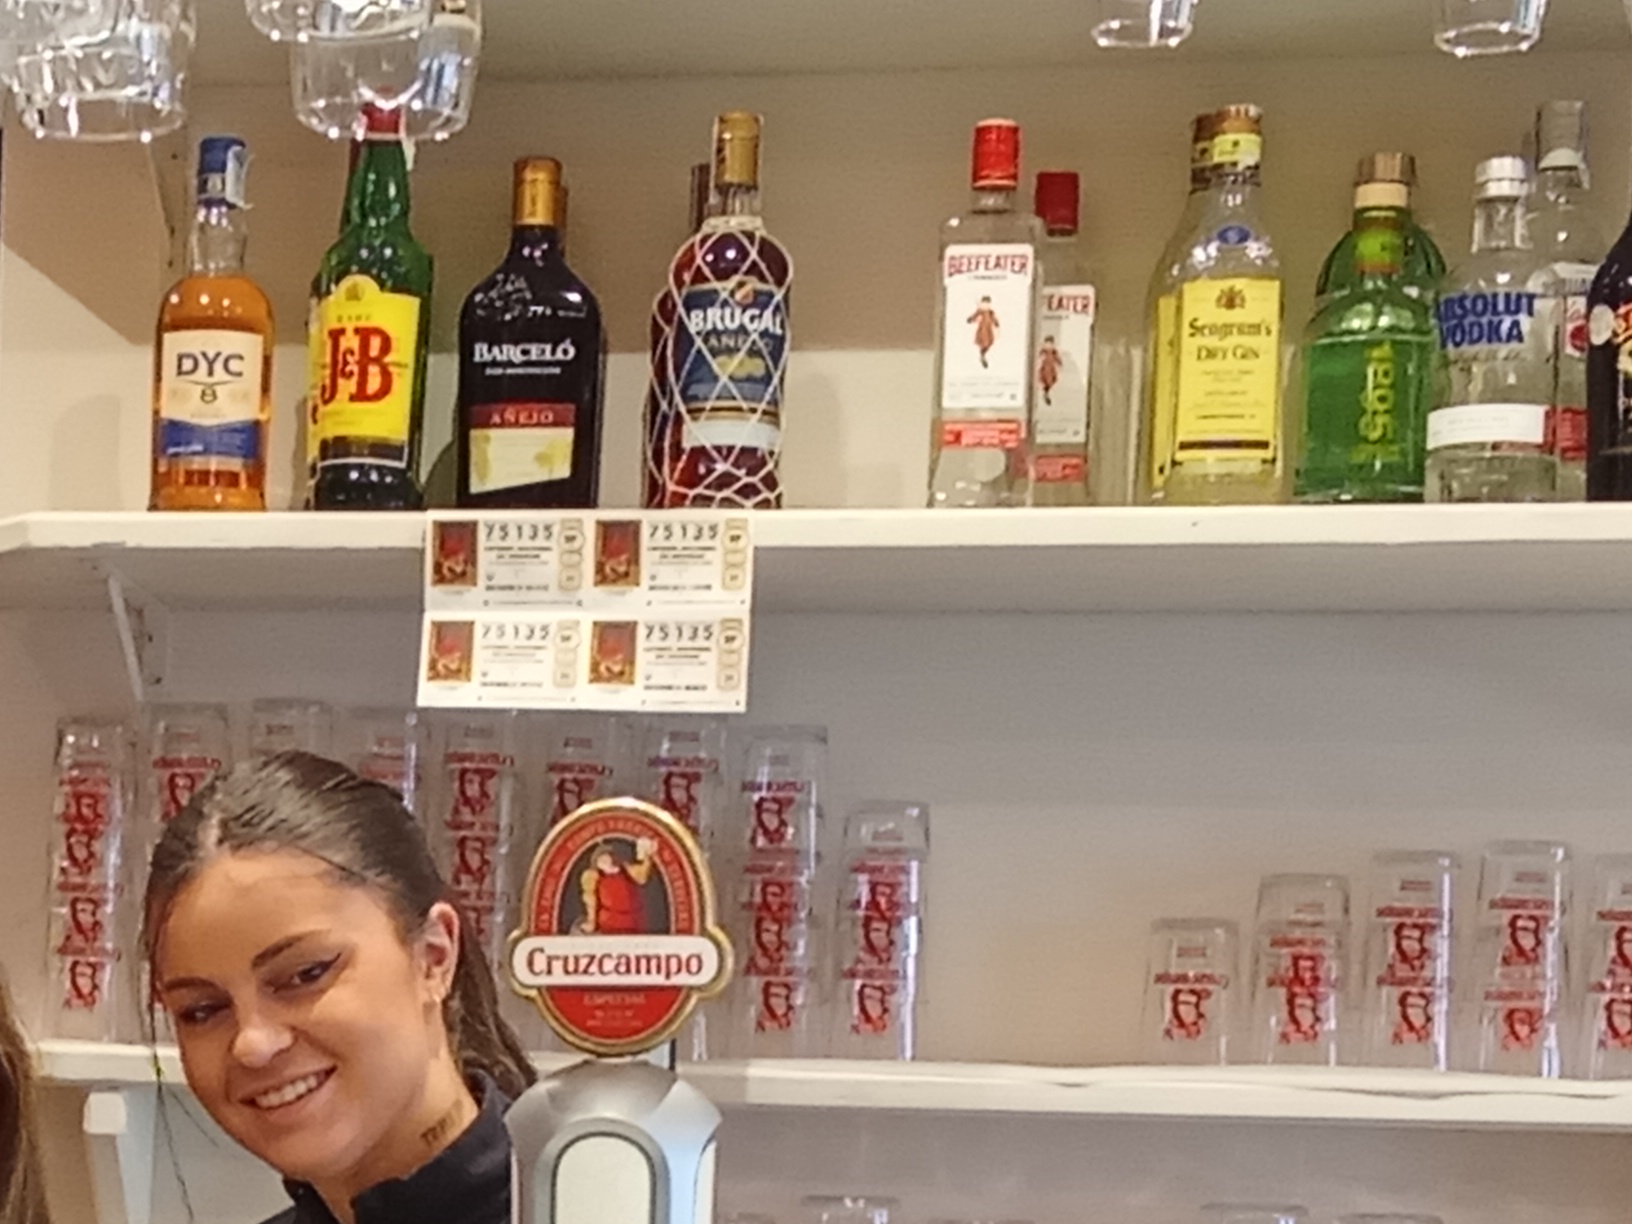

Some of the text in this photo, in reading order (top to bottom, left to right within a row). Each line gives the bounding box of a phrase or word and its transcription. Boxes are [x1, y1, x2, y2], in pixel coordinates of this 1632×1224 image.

[947, 254, 1029, 277] BEEFEATER
[1047, 294, 1092, 316] EATER
[689, 307, 783, 335] BRUGAL
[1187, 317, 1272, 341] Seagram's
[1440, 318, 1524, 349] VODKA
[473, 338, 576, 364] BARCELÓ
[1196, 345, 1228, 361] DRY
[176, 351, 245, 377] DYC
[320, 326, 394, 406] J&B
[490, 406, 555, 425] AÑEJO
[483, 523, 554, 541] 75135
[649, 523, 718, 541] 75135
[481, 624, 550, 641] 75135
[645, 624, 714, 641] 75135
[526, 947, 704, 981] Cruzcampo
